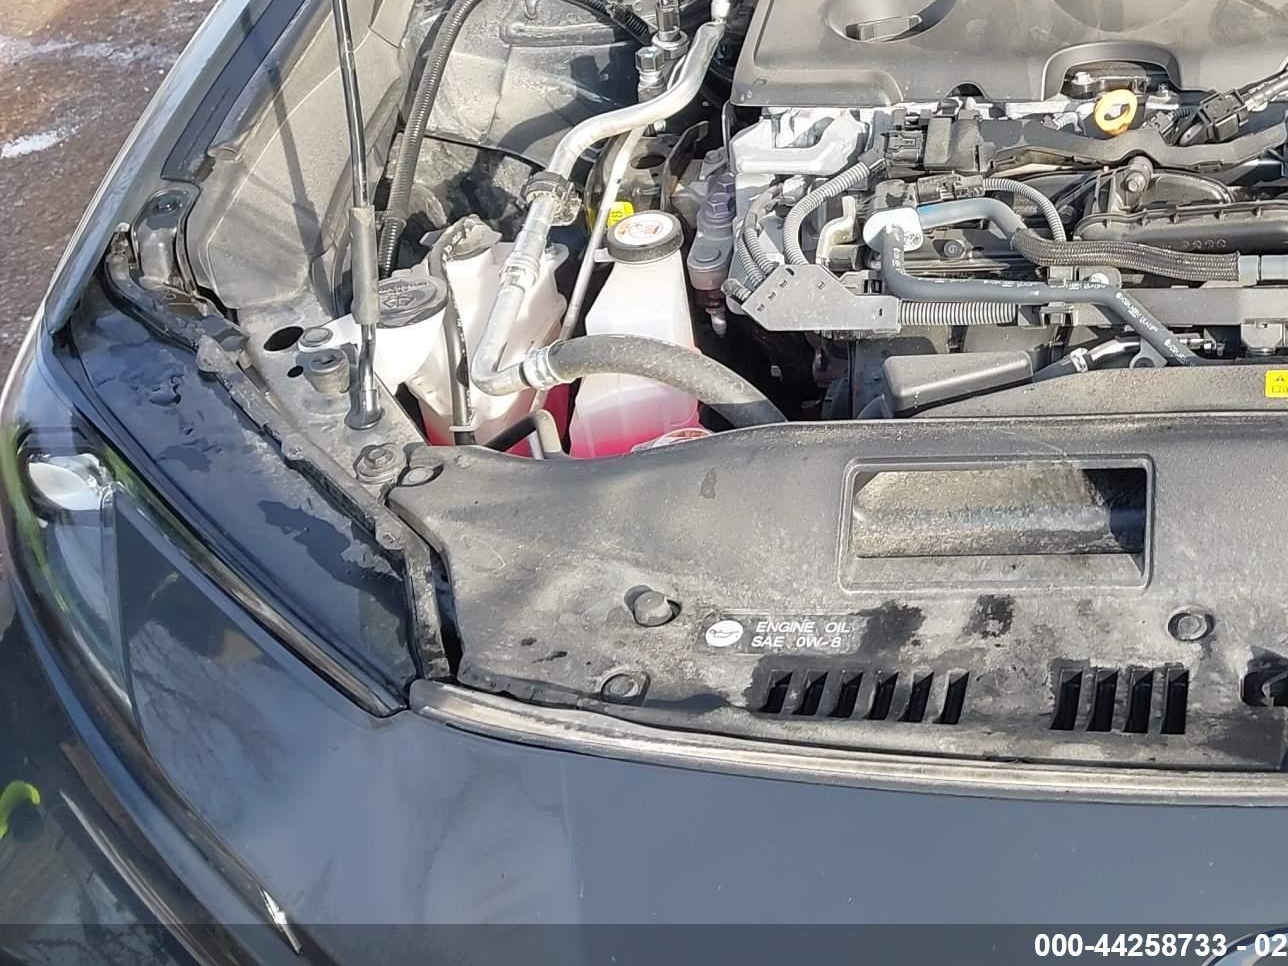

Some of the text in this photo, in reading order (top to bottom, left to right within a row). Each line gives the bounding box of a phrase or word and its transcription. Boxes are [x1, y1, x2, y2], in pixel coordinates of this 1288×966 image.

[755, 621, 852, 634] ENGINE OIL
[751, 635, 842, 648] SAE 0W-8
